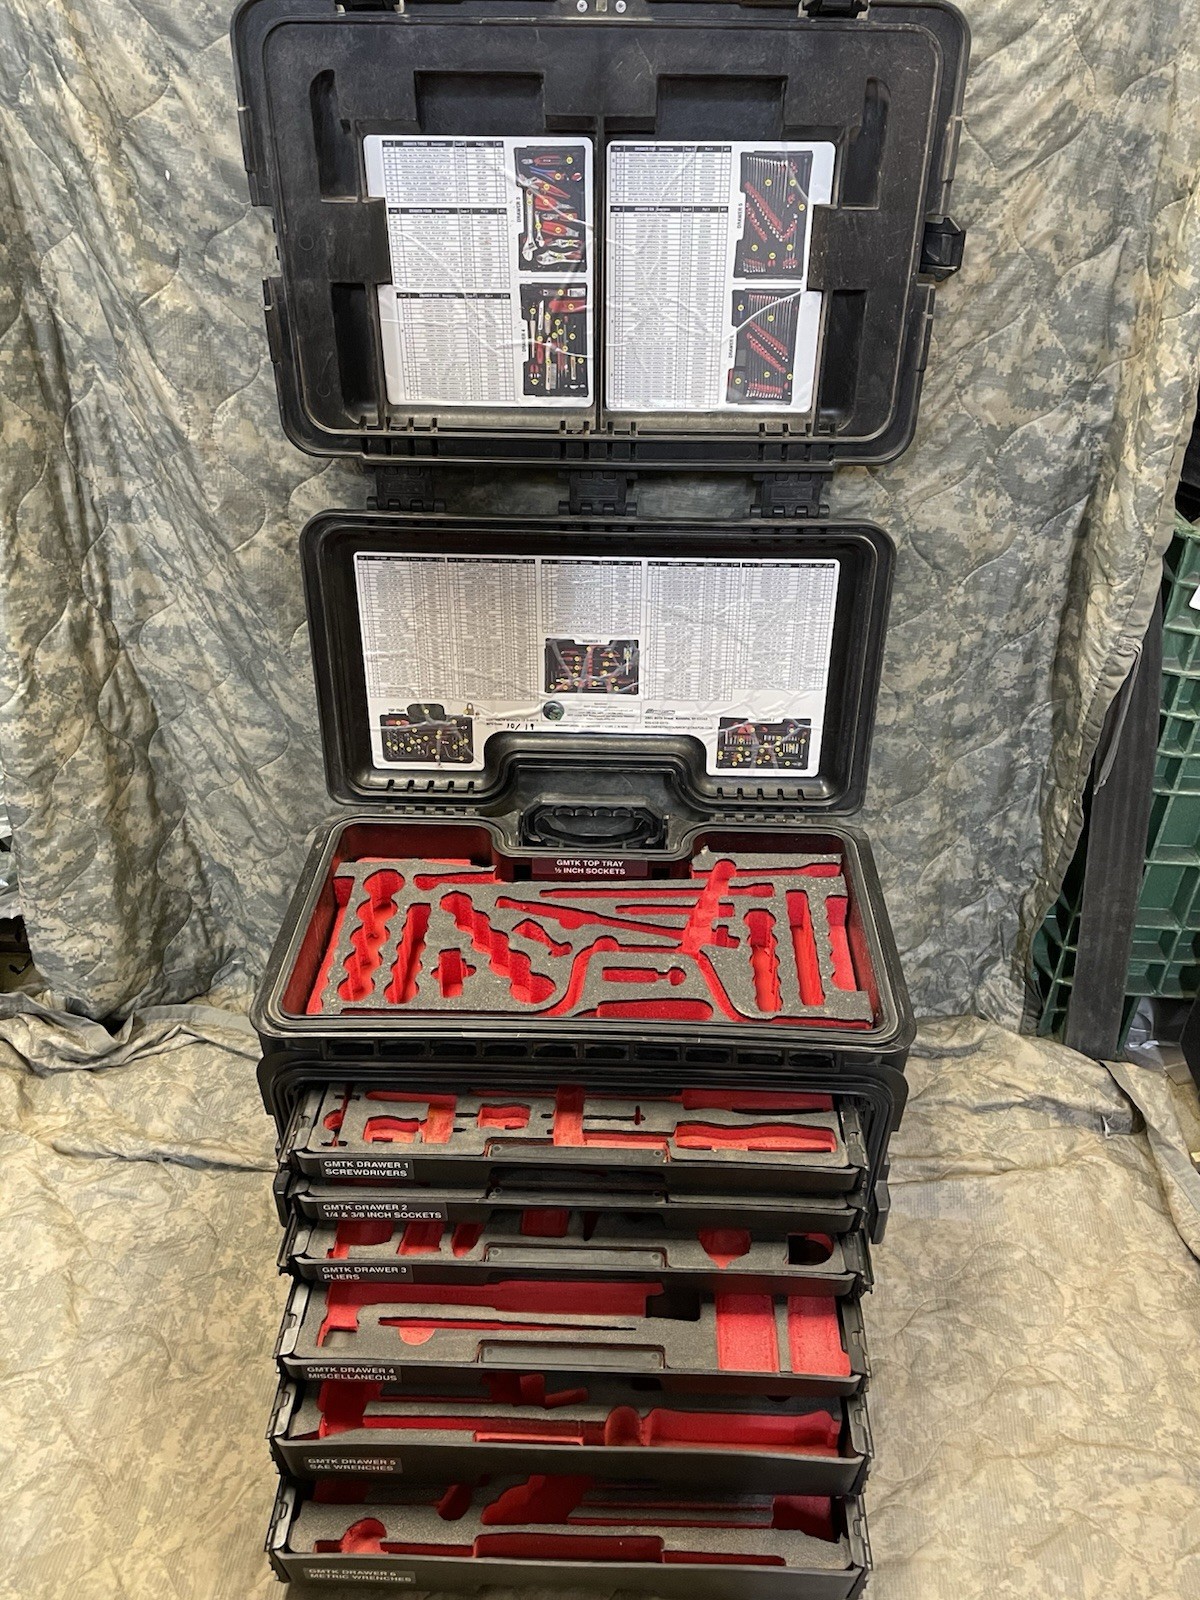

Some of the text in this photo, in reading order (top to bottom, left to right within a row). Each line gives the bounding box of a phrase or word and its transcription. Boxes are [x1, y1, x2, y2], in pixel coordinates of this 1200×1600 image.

[356, 1161, 401, 1169] DRAWER
[325, 1169, 407, 1177] SCREWDRIVERS
[308, 1373, 398, 1381] MISCELLANEOUS
